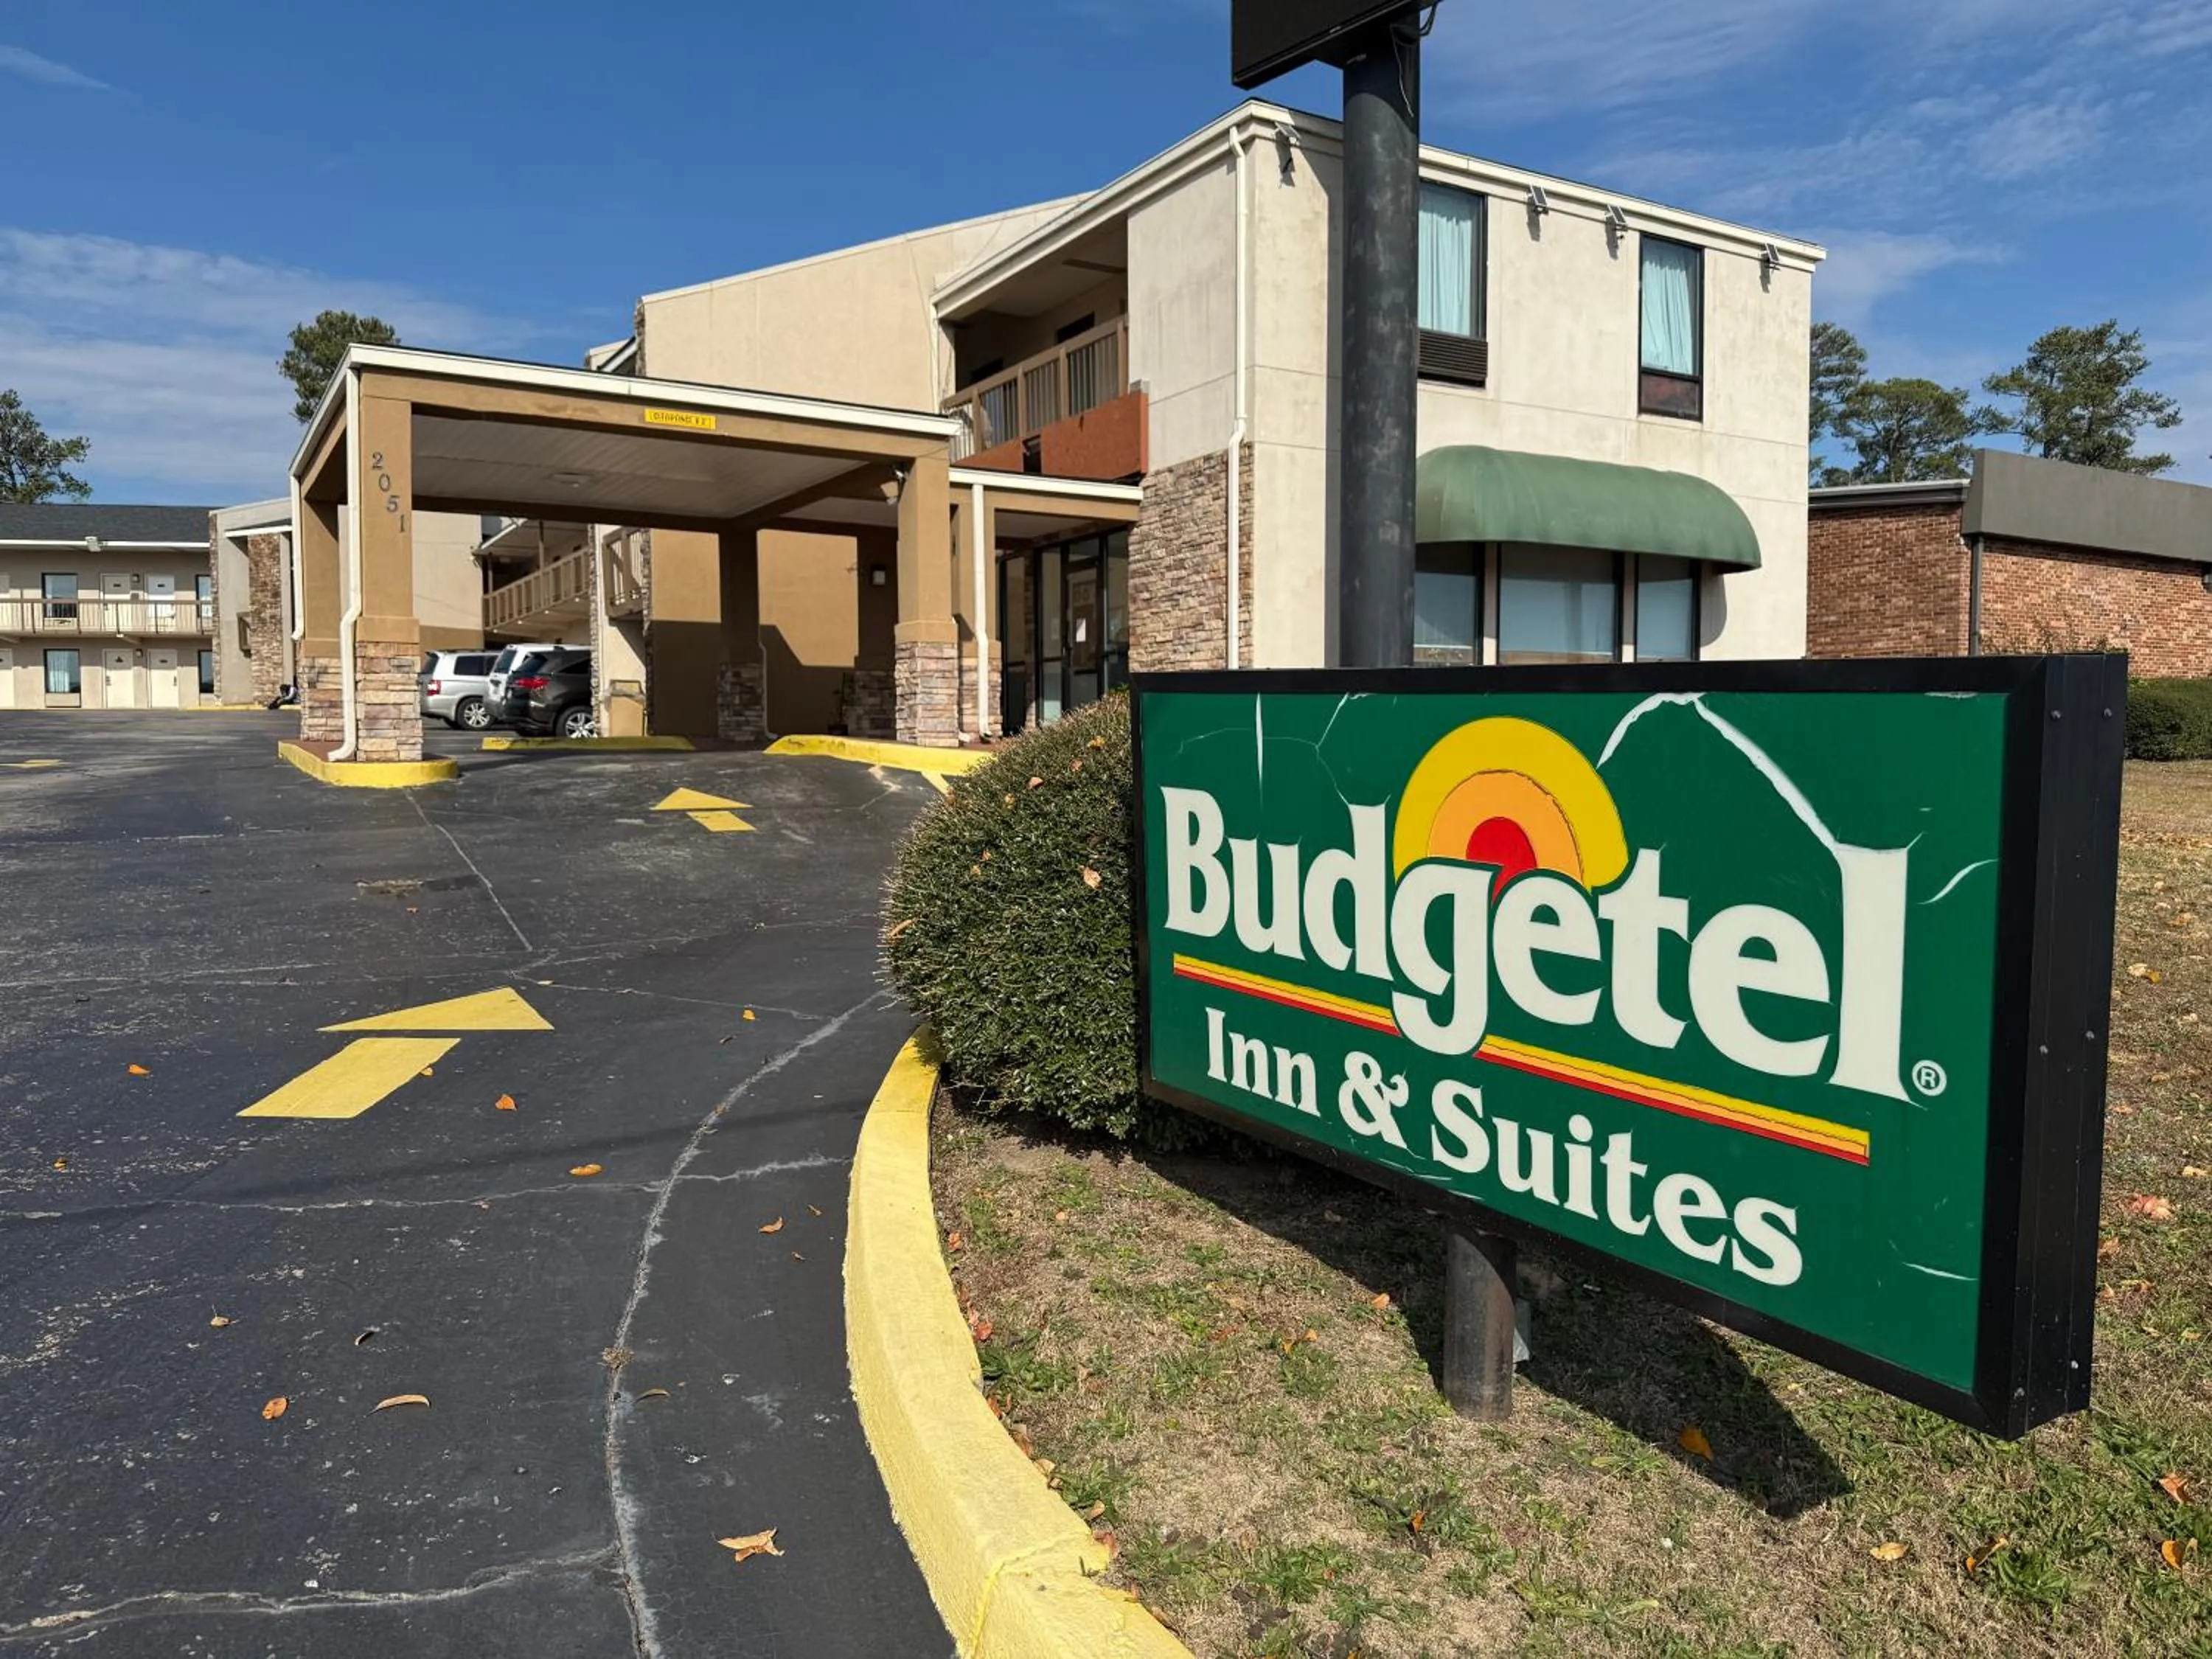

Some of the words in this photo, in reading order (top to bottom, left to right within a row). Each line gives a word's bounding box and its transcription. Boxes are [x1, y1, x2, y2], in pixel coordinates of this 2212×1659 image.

[372, 451, 405, 532] 2051
[1160, 786, 1913, 1103] Budgetel
[1205, 1006, 1321, 1117] Inn
[1338, 1051, 1409, 1150] &
[1431, 1079, 1803, 1287] Suites
